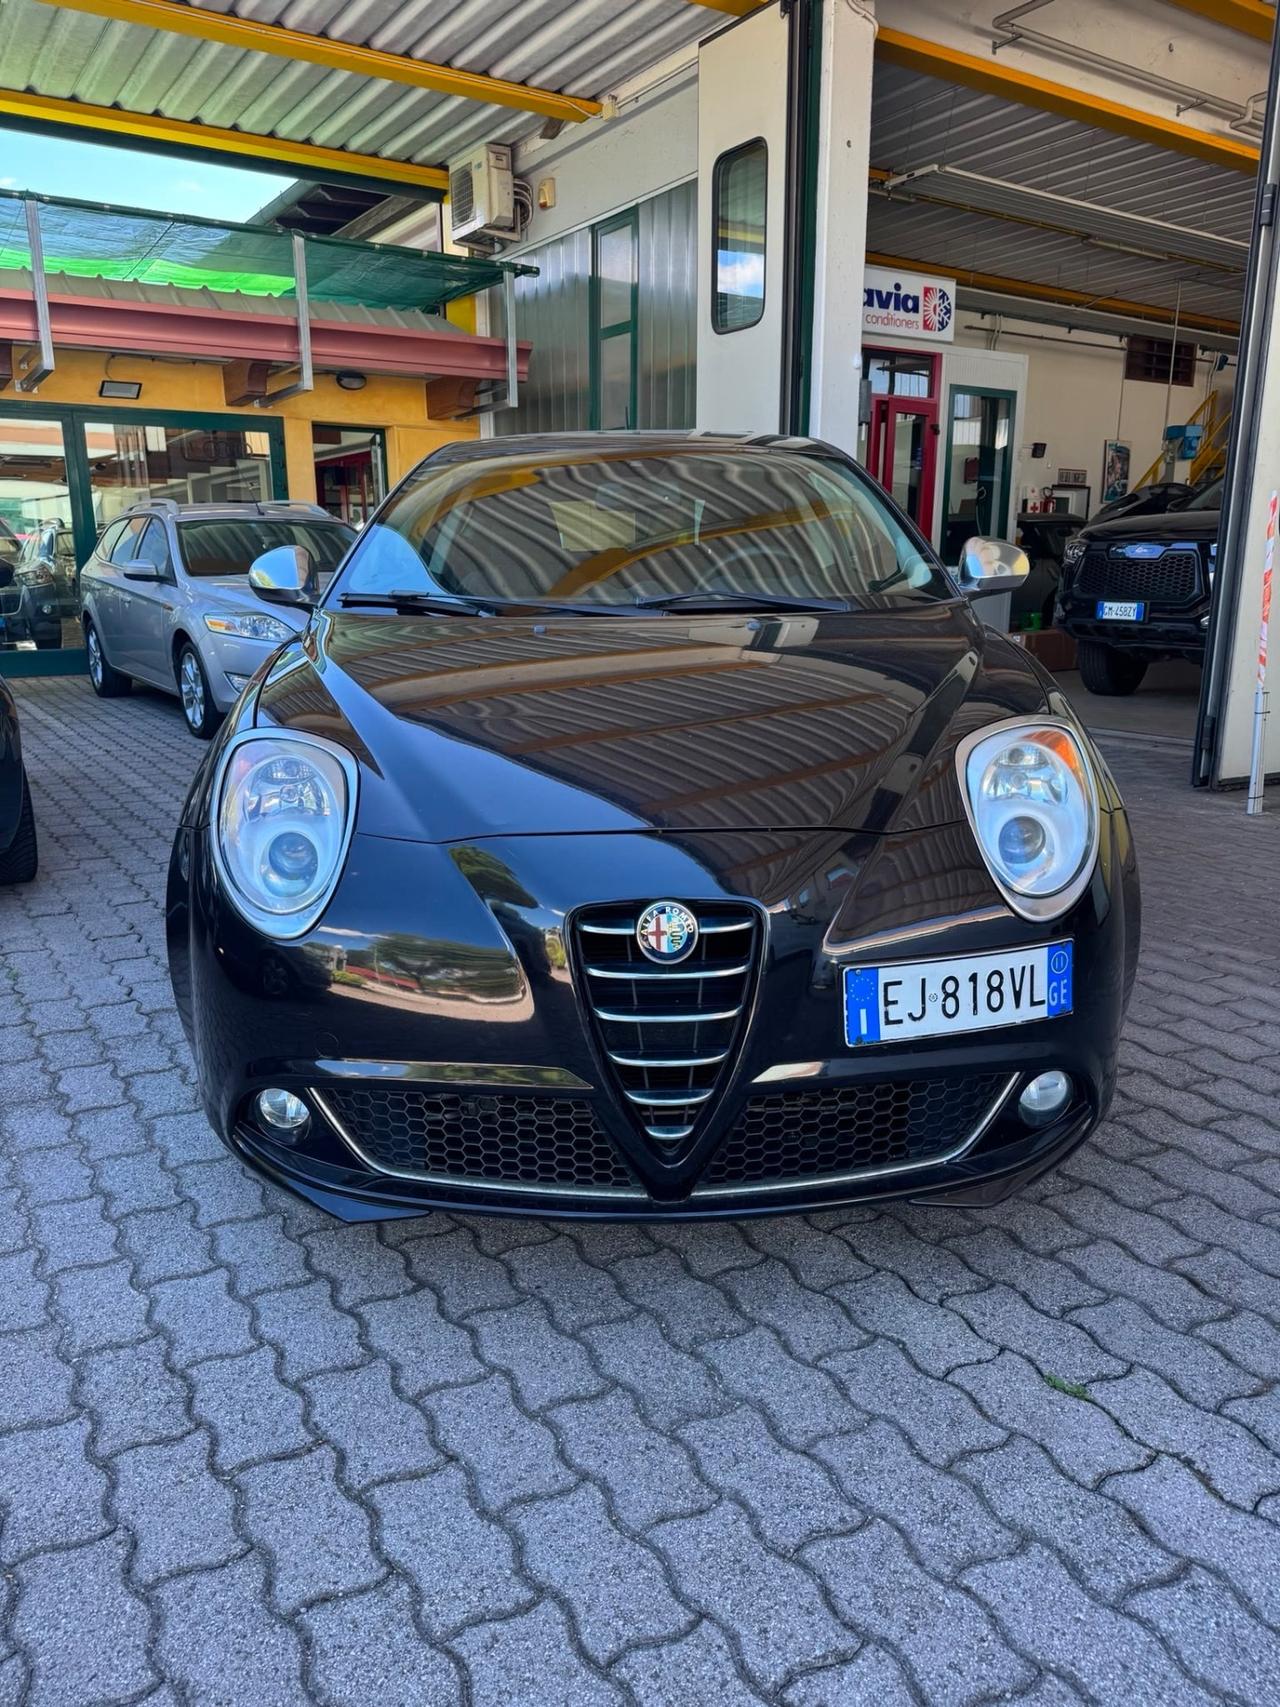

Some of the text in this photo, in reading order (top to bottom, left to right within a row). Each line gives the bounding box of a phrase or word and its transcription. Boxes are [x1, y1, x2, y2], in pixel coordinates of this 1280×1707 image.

[865, 312, 920, 330] conditioners
[640, 906, 695, 936] ALFA ROMEO
[1049, 979, 1068, 1006] GE
